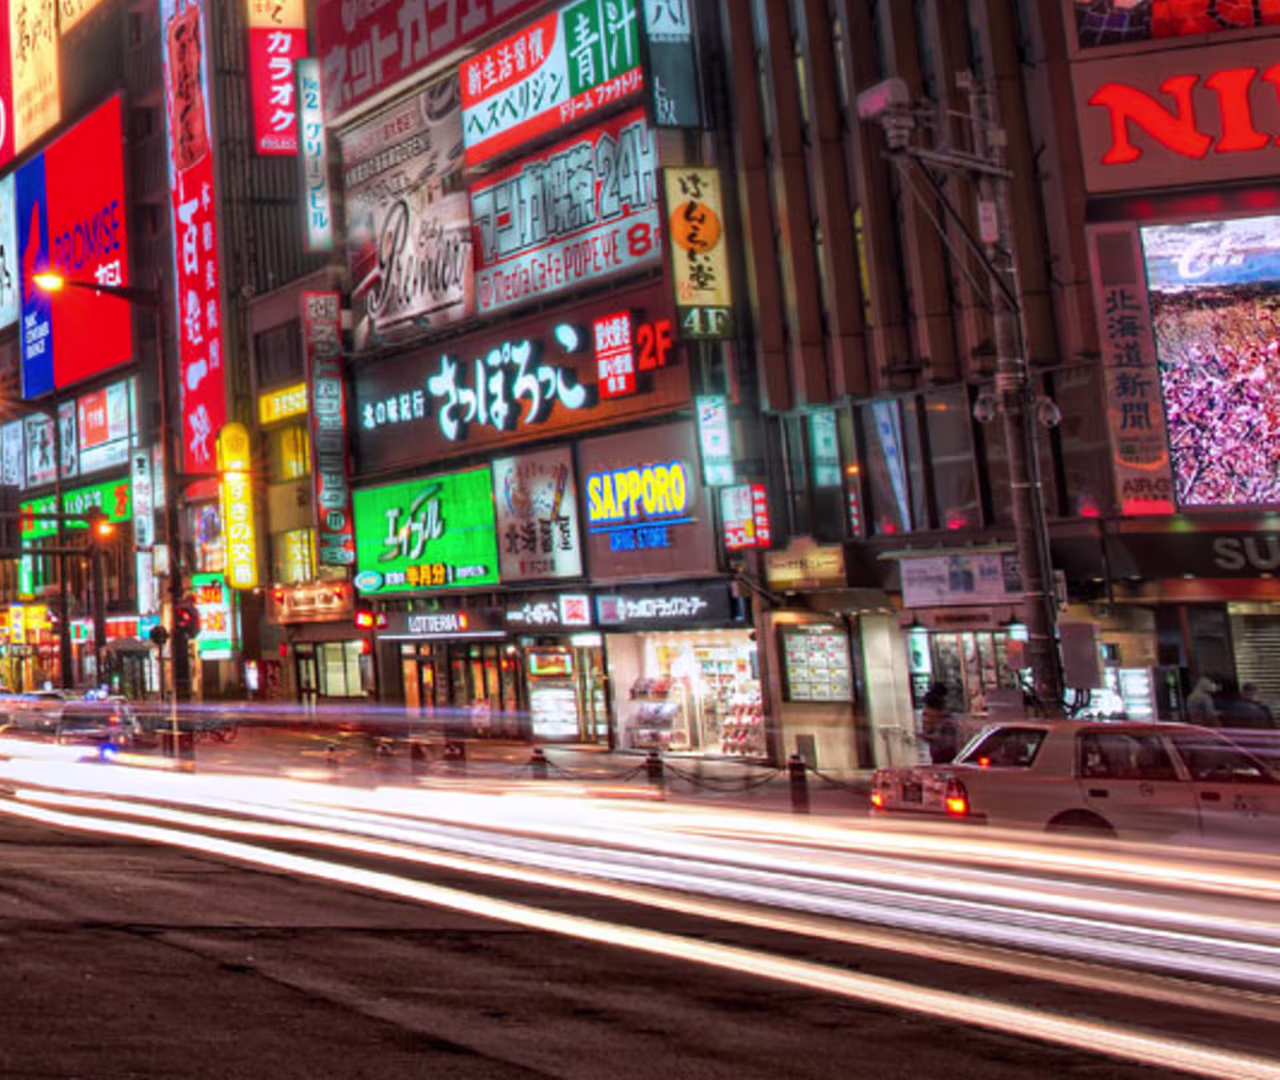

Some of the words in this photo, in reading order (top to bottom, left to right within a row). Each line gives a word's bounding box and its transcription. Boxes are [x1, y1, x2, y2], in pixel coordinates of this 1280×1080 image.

[265, 29, 297, 132] カラオケ
[466, 70, 565, 137] ヘスペリジン
[1087, 65, 1280, 168] NI
[596, 119, 662, 222] 24H
[563, 229, 623, 283] POPEYE
[636, 320, 673, 371] 2F
[682, 306, 730, 336] 4F
[1105, 289, 1154, 432] 北海道新聞
[588, 463, 688, 522] SAPPORO
